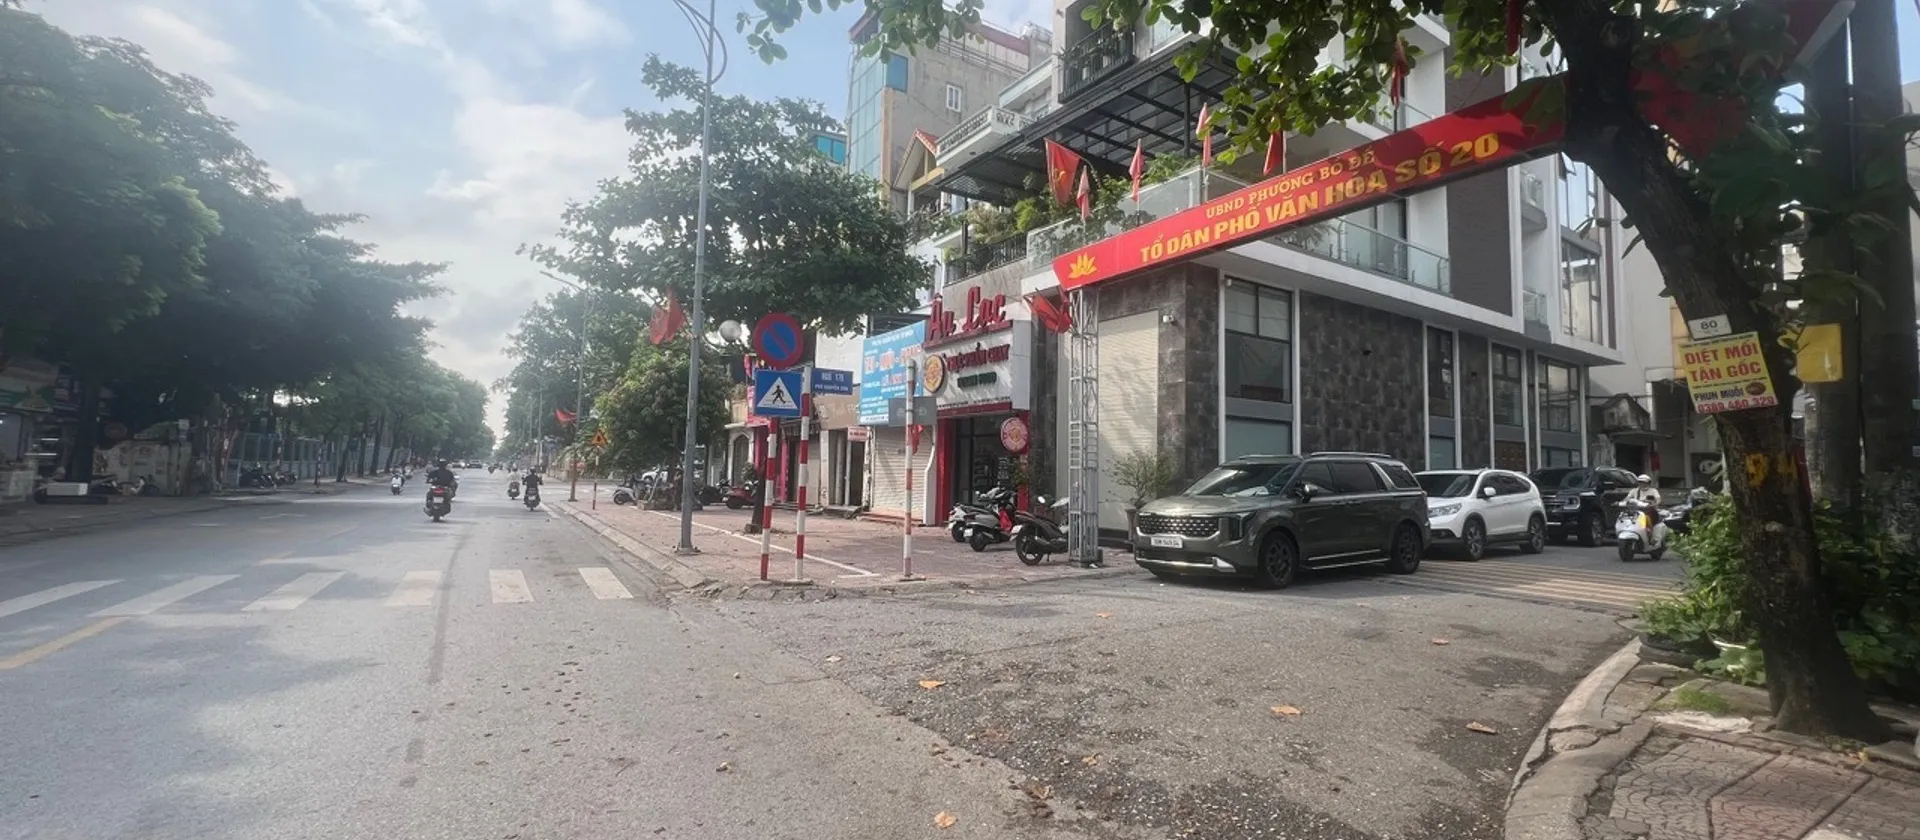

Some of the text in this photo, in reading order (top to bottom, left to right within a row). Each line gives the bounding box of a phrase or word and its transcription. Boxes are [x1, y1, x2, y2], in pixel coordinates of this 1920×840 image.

[1167, 226, 1210, 255] DÂN
[1214, 203, 1260, 240] PHỐ
[1265, 194, 1318, 223] VĂN
[1394, 139, 1445, 184] SỐ
[1450, 132, 1499, 168] 20
[1206, 197, 1245, 219] UBND
[1700, 320, 1718, 330] 80
[1684, 348, 1719, 366] DIỆT
[1727, 359, 1762, 378] GỐC
